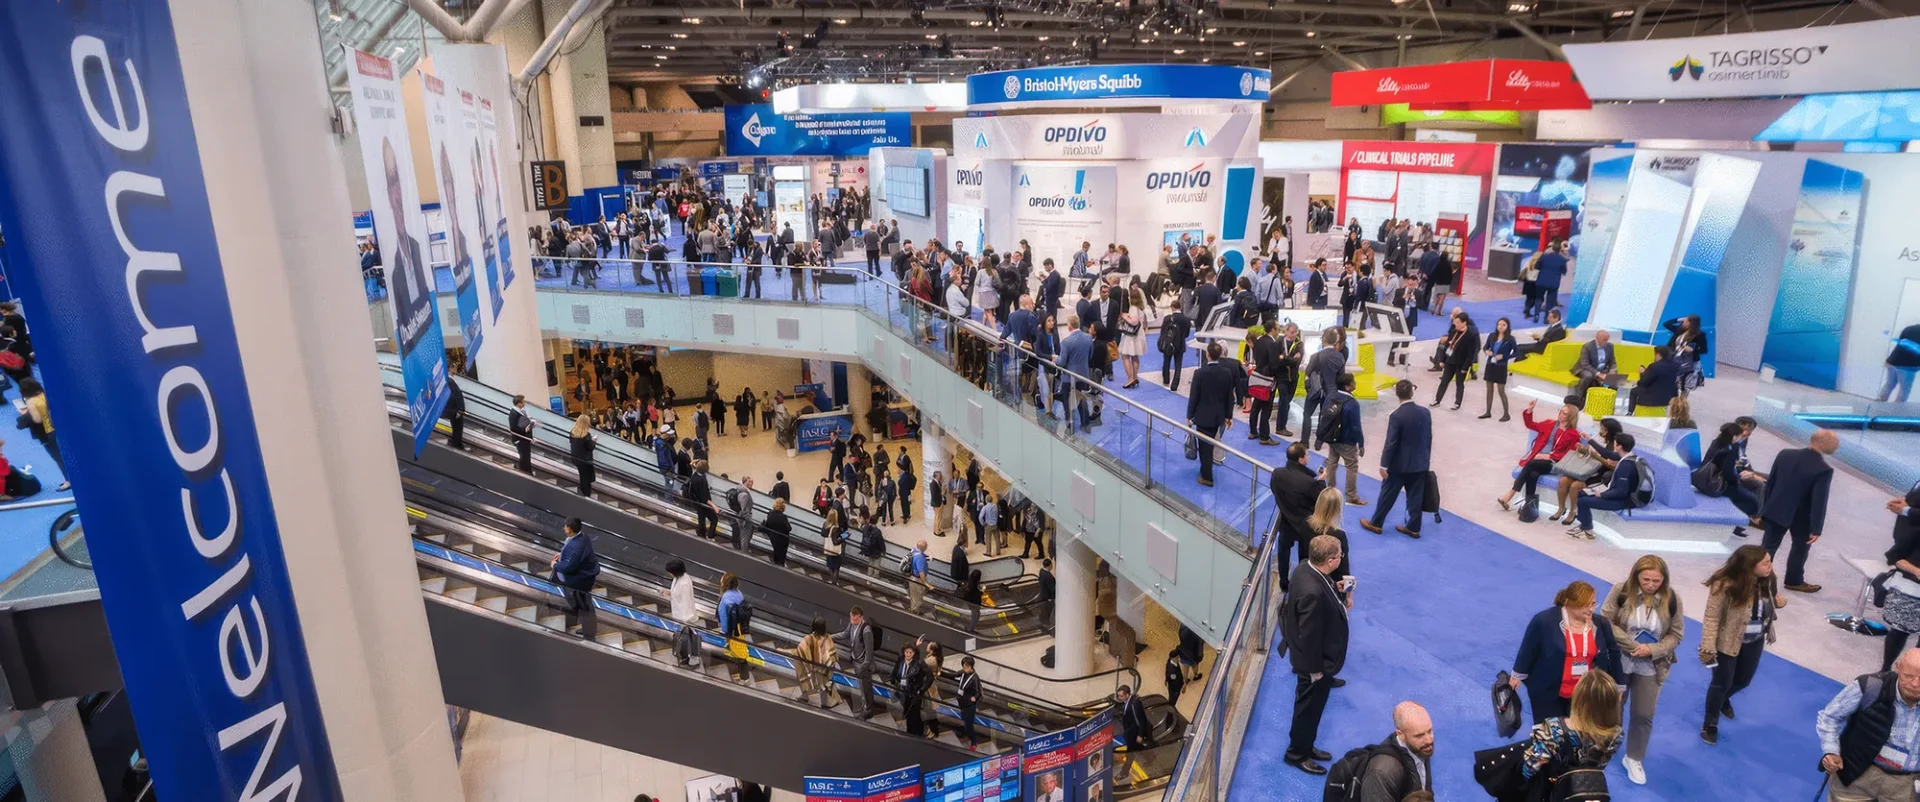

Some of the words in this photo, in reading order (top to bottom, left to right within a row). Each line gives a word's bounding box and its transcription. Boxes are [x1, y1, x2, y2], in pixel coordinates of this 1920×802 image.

[1709, 47, 1812, 67] TAGRISSO
[1098, 74, 1142, 92] Squibb
[1708, 67, 1790, 82] osimertinib
[1044, 123, 1107, 143] OPDIVO
[543, 164, 565, 206] B
[1146, 167, 1211, 190] OPDIVO
[1029, 196, 1065, 208] OPDIVO
